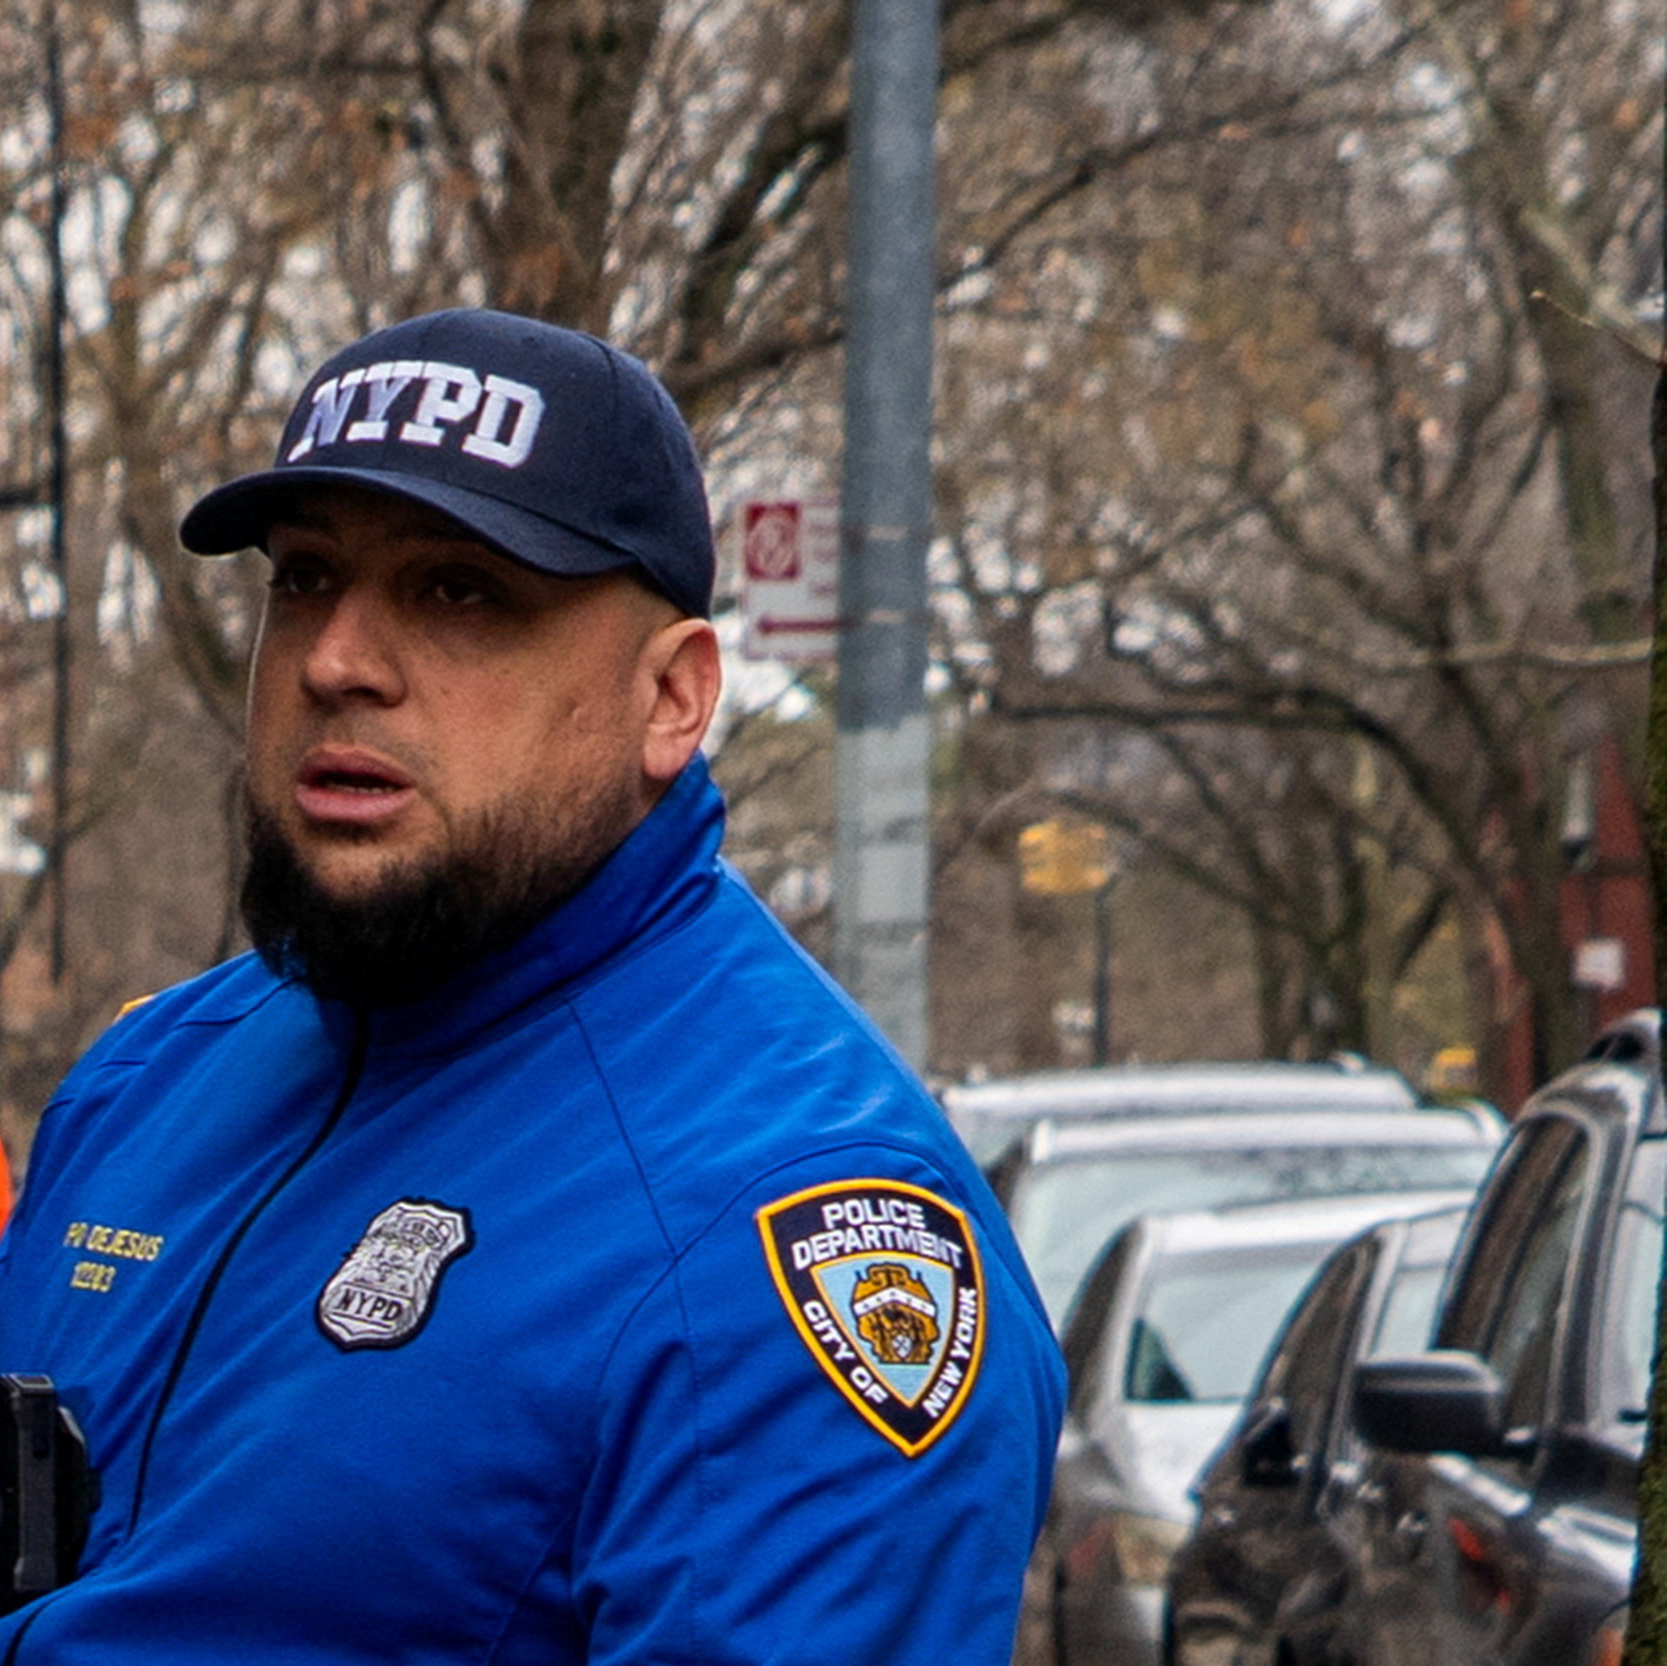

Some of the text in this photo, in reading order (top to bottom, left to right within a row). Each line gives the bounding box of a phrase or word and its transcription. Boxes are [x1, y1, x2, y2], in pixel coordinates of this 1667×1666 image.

[286, 359, 546, 469] NYPD
[821, 1198, 926, 1230] POLICE
[87, 1226, 163, 1260] DEJESUS
[791, 1224, 963, 1271] DEPARTMENT
[336, 1289, 402, 1320] NYPD
[804, 1287, 977, 1418] CITY OF NEW YORK
